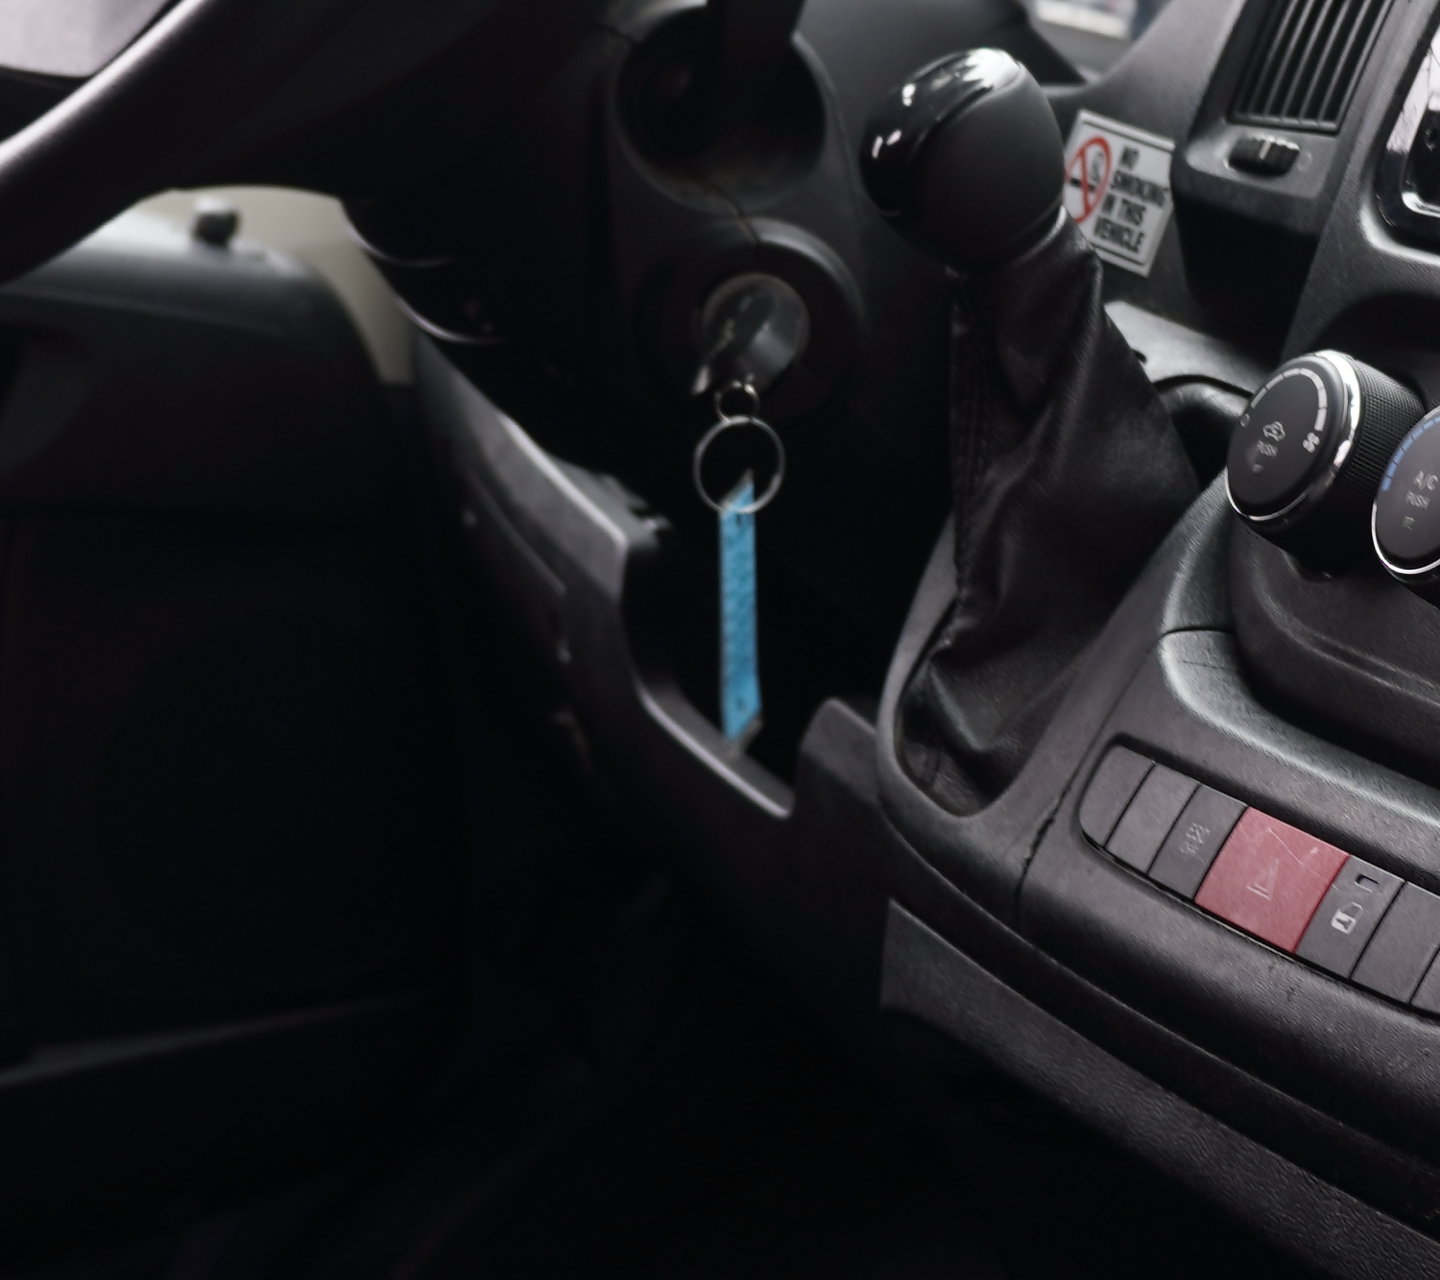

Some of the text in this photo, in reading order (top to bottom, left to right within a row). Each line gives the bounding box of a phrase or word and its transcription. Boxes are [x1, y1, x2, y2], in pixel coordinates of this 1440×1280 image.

[1119, 145, 1139, 170] NO
[1101, 192, 1147, 226] IN THIS
[1093, 216, 1145, 253] VEHICLE
[1413, 470, 1439, 491] A/C
